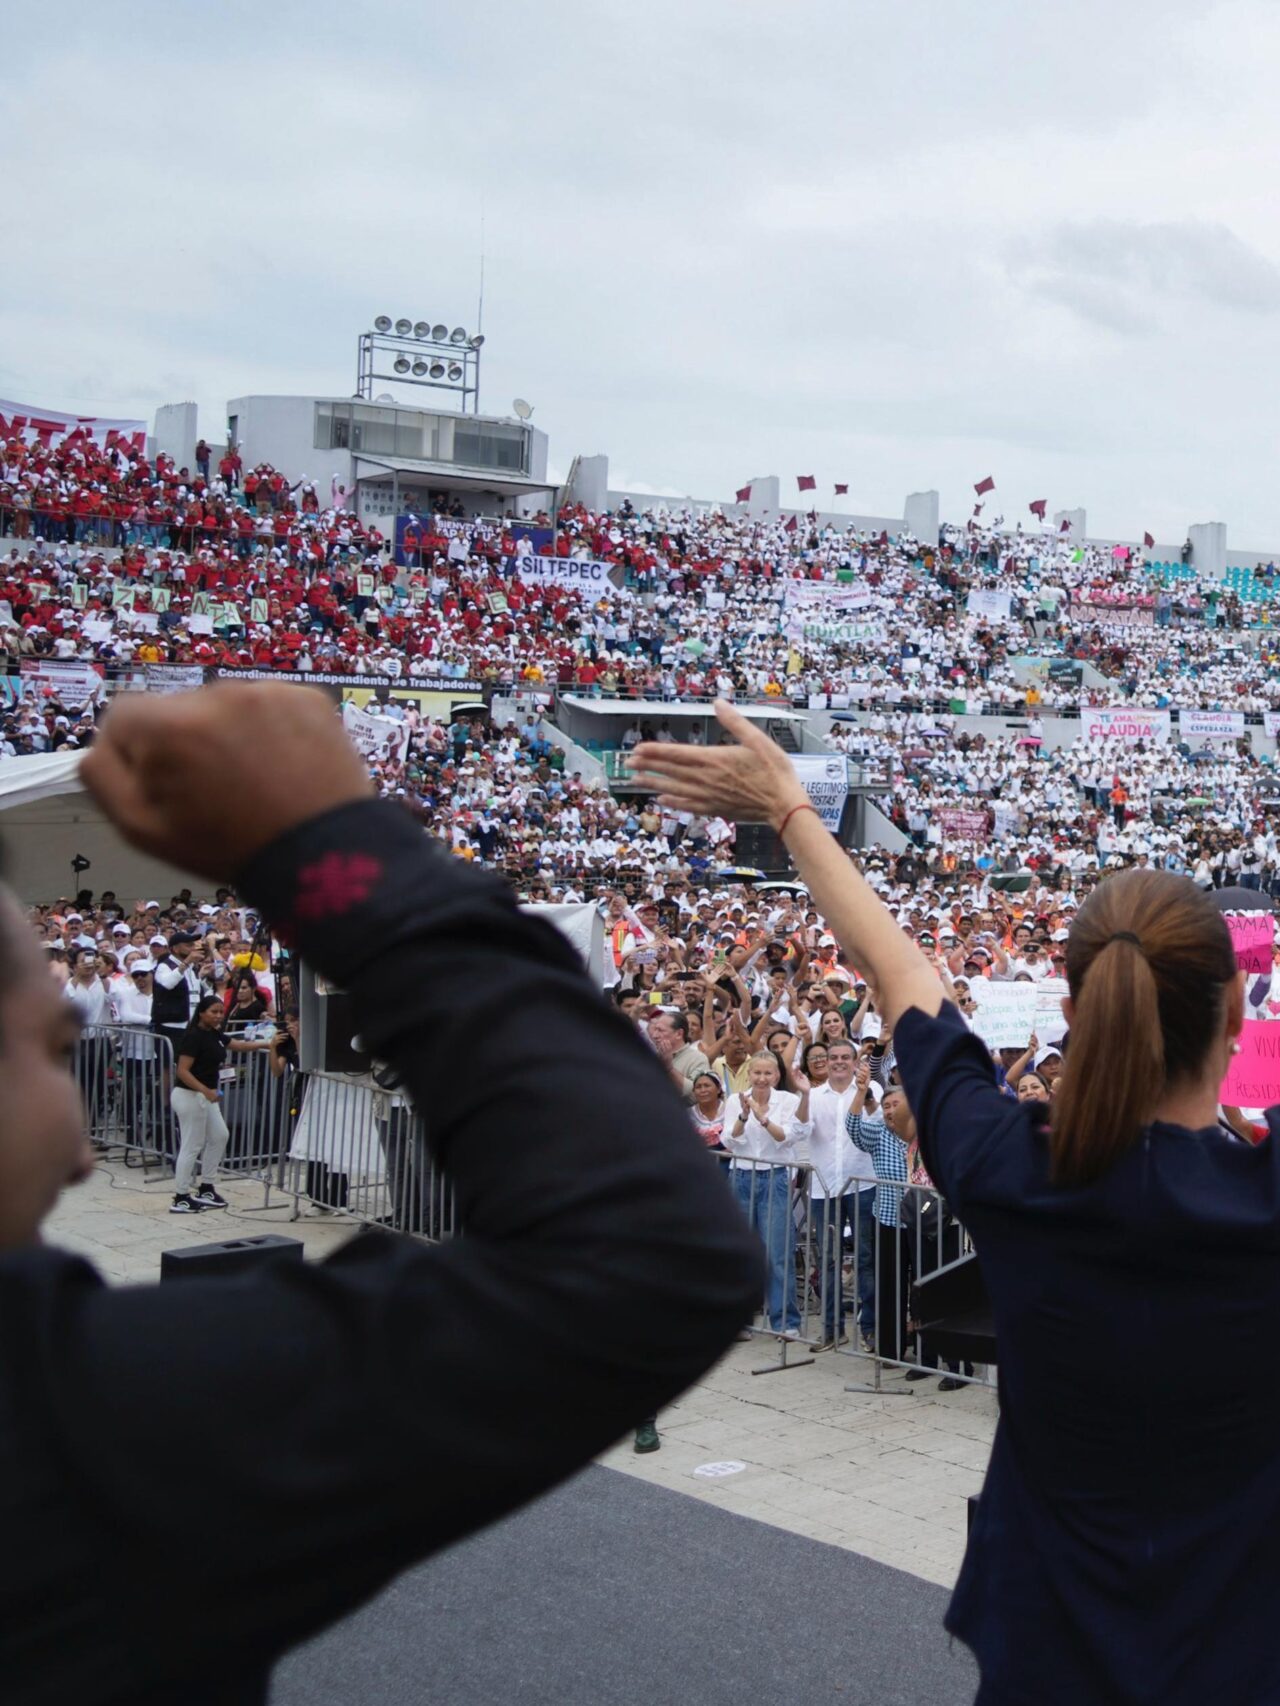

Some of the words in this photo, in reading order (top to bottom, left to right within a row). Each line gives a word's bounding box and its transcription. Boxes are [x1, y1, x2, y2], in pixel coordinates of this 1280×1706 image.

[522, 556, 602, 580] SILTEPEC
[218, 668, 301, 682] Coordinadora
[304, 673, 388, 686] Independiente
[409, 678, 482, 690] Trabajadores
[1090, 724, 1151, 736] CLAUDIA
[806, 782, 848, 793] LEGITIMOS
